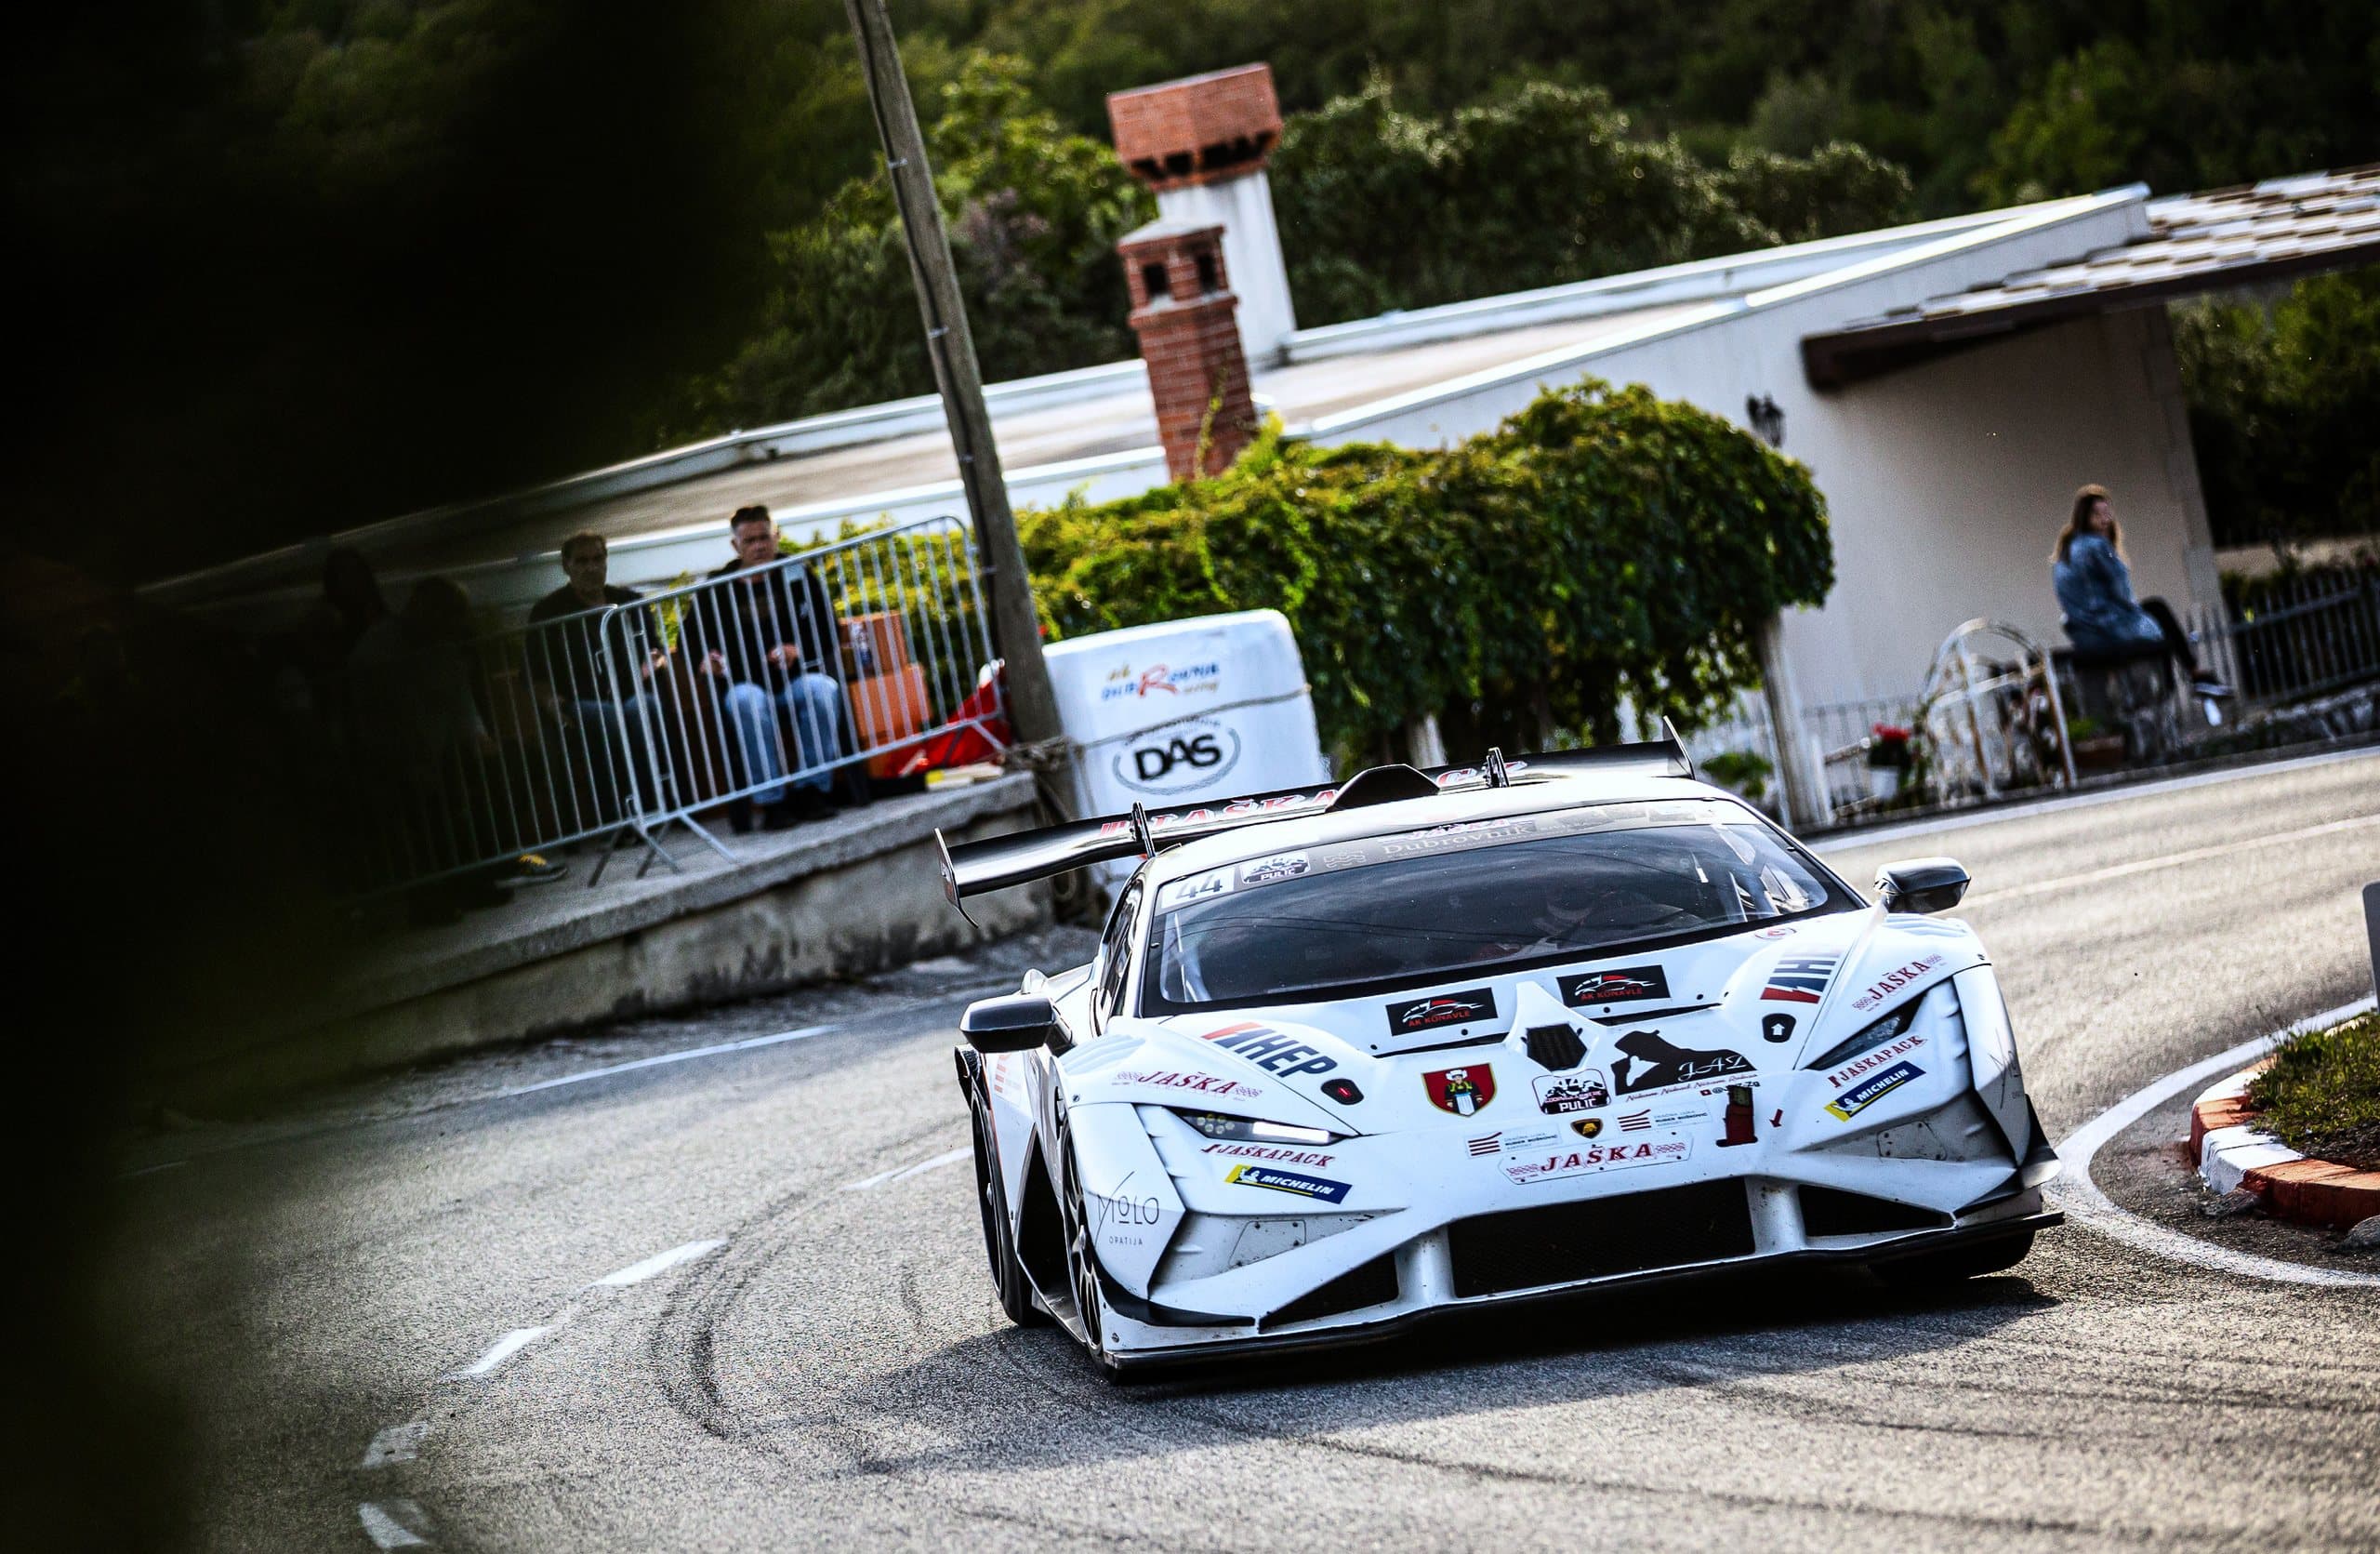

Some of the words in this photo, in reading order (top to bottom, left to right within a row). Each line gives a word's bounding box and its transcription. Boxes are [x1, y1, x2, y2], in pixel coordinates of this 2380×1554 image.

[1134, 733, 1223, 781] DAS
[1175, 872, 1223, 898] 44
[1868, 960, 1931, 1002] JAŠKA
[1841, 1035, 1924, 1082] JAŠKAPACK
[1137, 1071, 1238, 1095] JAŠKA
[1857, 1069, 1911, 1103] MICHELIN
[1216, 1145, 1336, 1168] JAŠKAPACK
[1540, 1143, 1653, 1172] JAŠKA
[1260, 1175, 1335, 1196] MICHELIN
